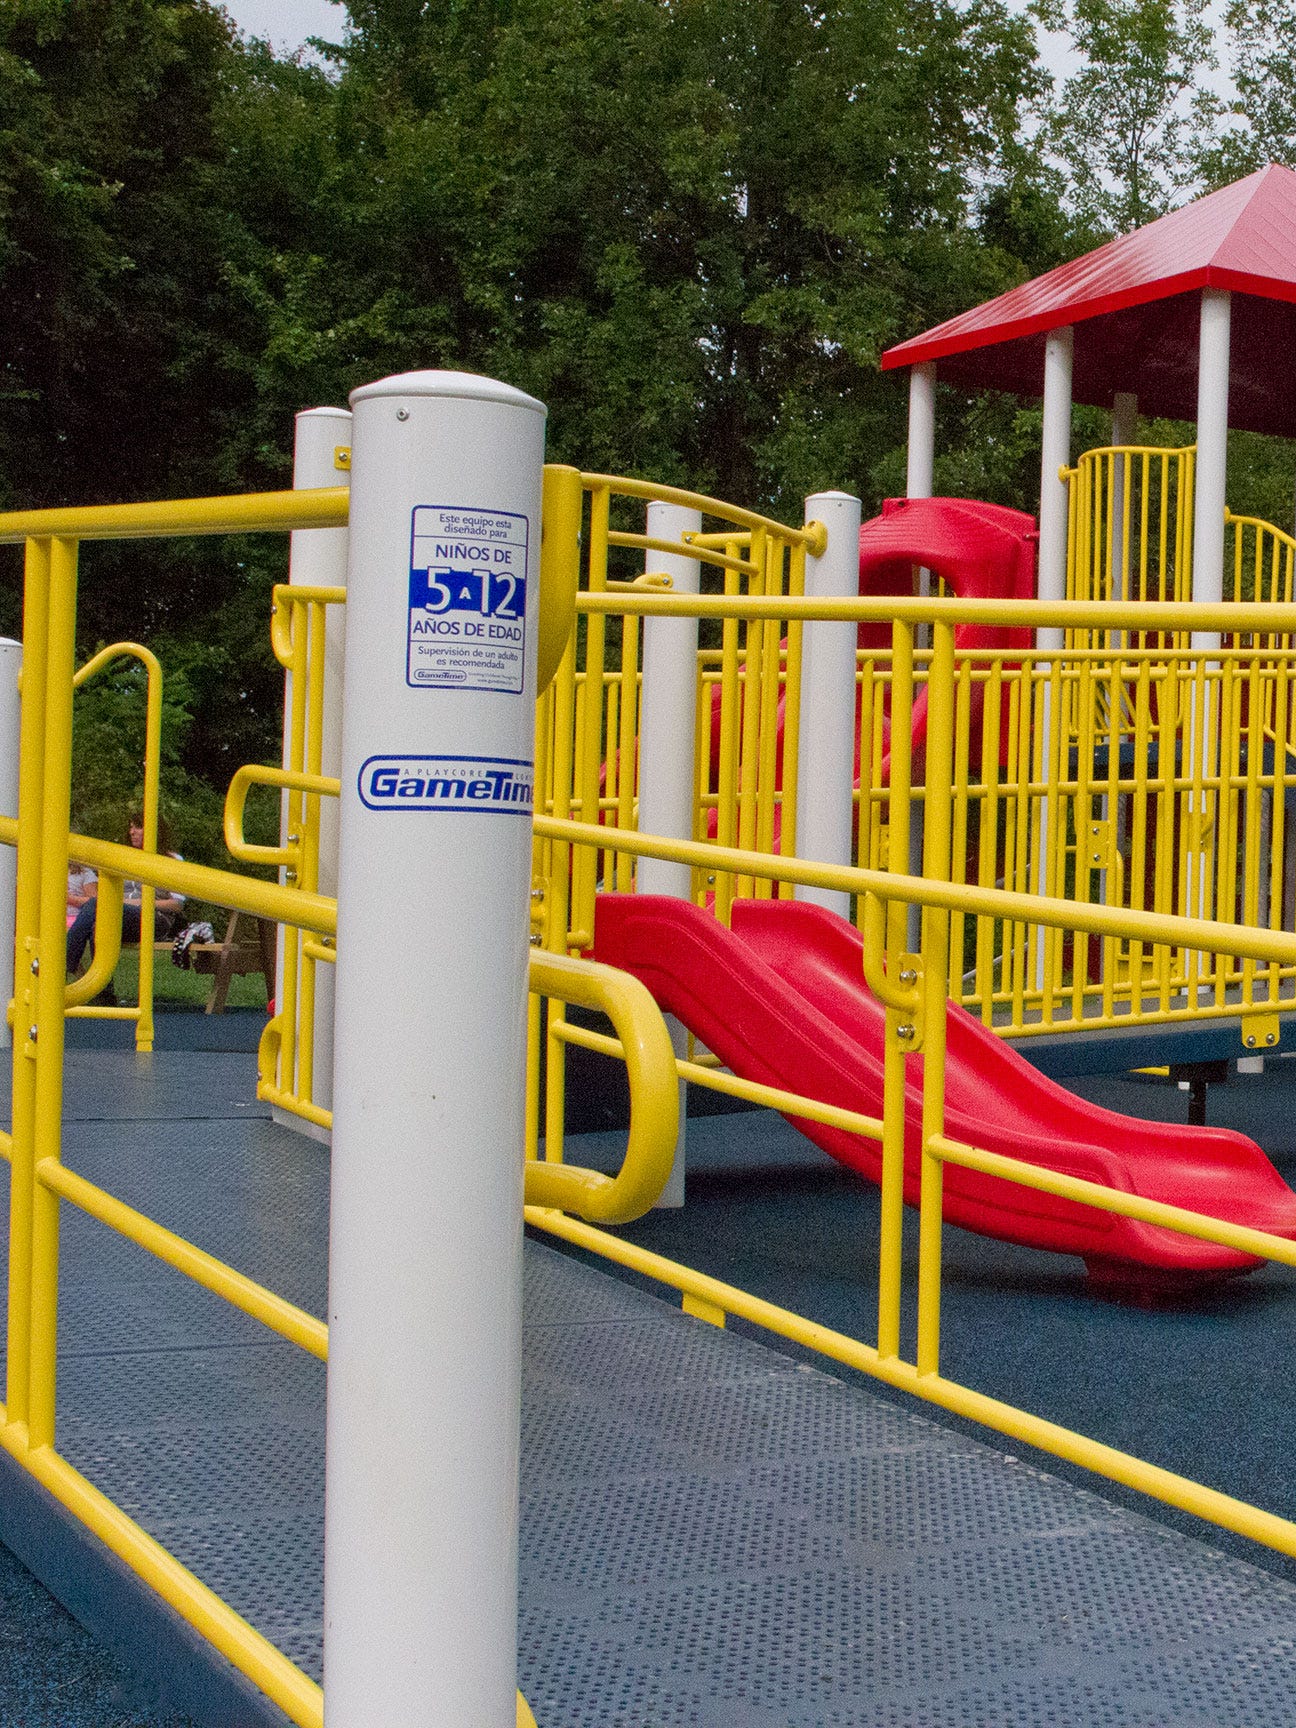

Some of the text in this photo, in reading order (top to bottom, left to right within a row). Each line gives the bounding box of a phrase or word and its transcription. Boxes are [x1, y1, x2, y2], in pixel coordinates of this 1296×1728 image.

[439, 513, 512, 529] Este equipo esta
[444, 524, 507, 538] diseñado para
[436, 542, 512, 564] NIÑOS DE
[425, 566, 518, 619] 5 A 12
[413, 617, 522, 641] AÑOS DE EDAD
[418, 646, 470, 657] Supervisión
[472, 649, 483, 657] de
[498, 652, 518, 661] adulto
[449, 658, 505, 669] recomendada
[417, 768, 482, 777] PLAYCORE
